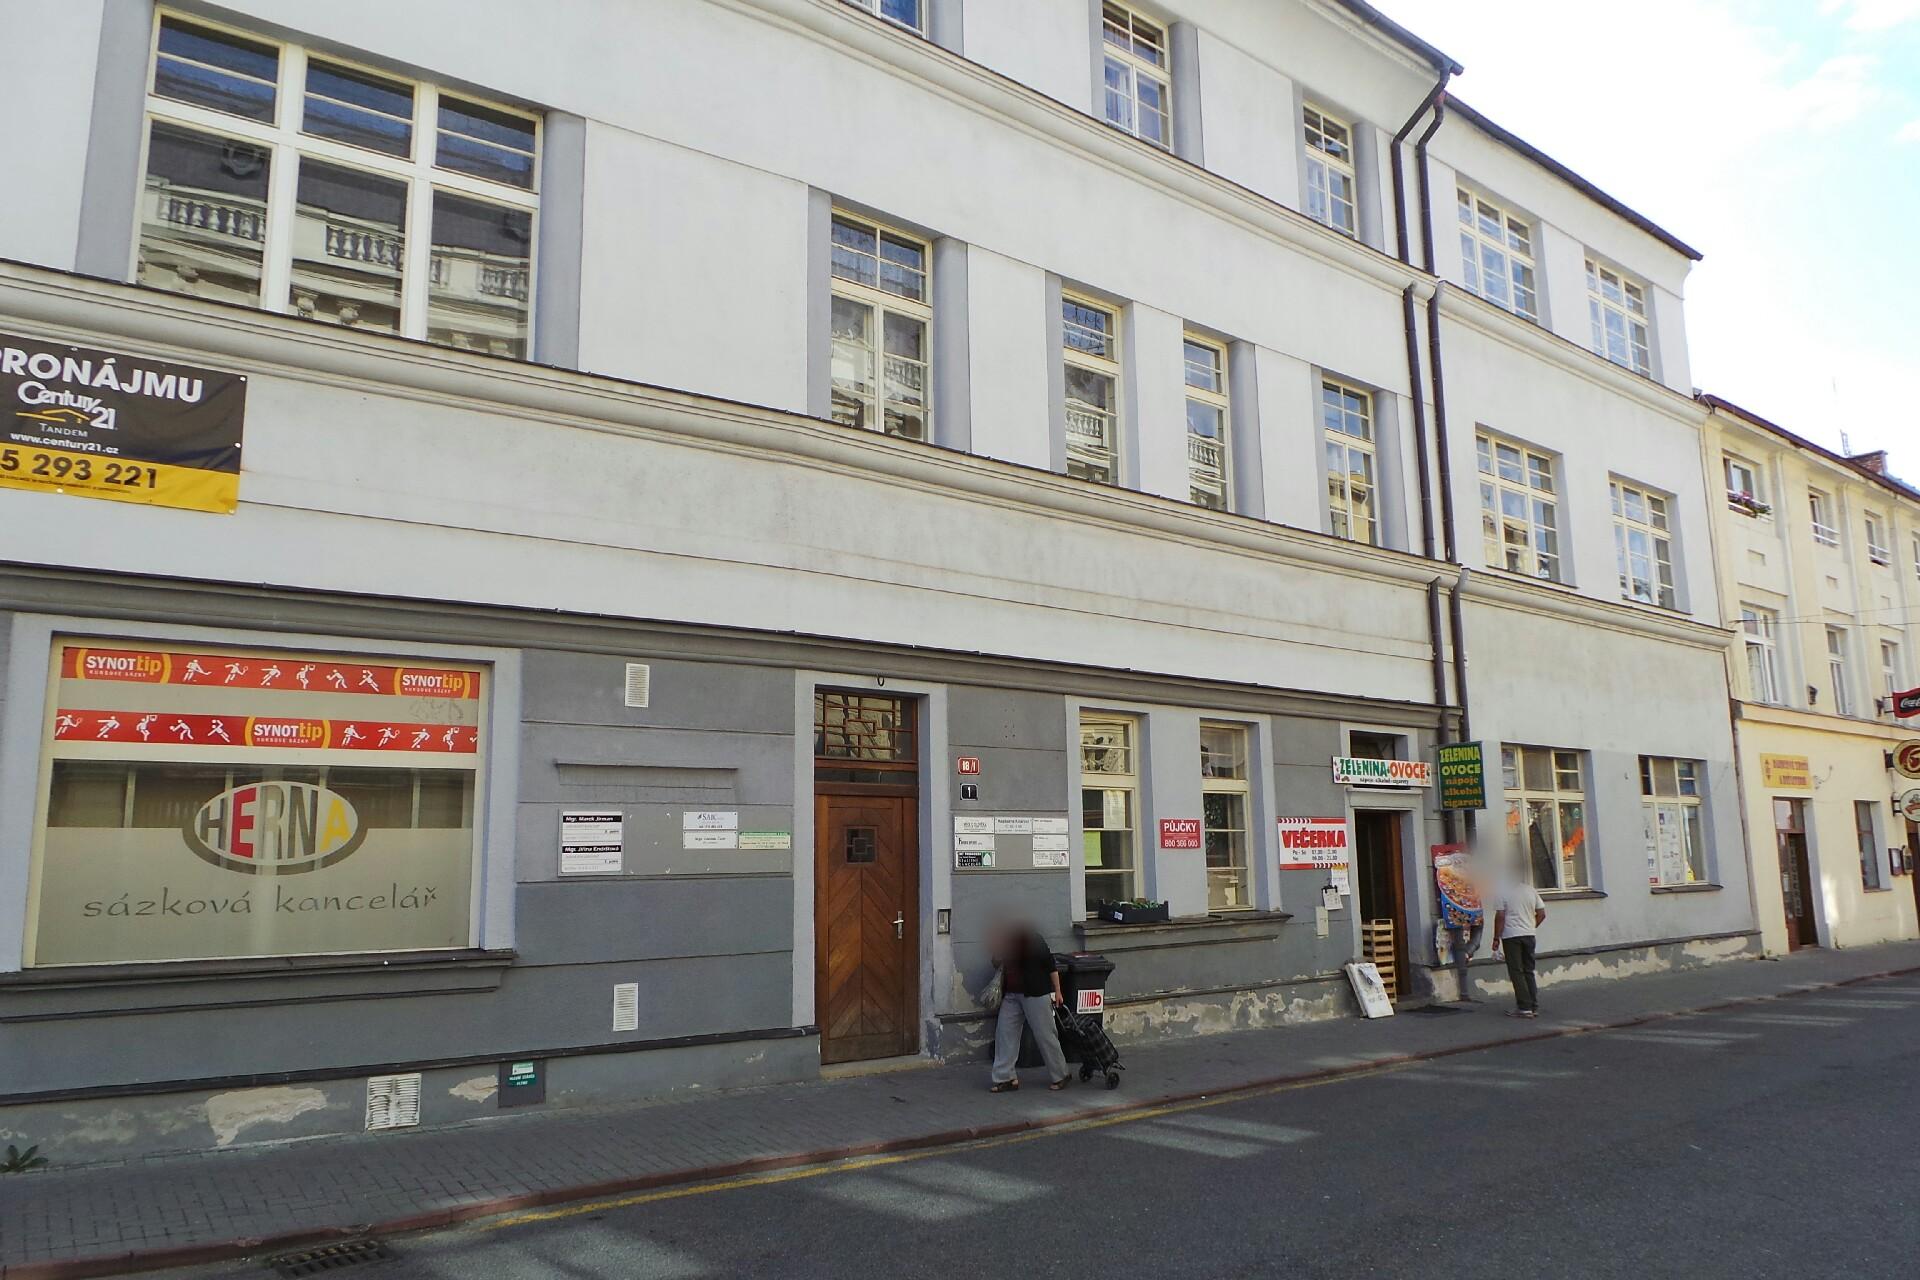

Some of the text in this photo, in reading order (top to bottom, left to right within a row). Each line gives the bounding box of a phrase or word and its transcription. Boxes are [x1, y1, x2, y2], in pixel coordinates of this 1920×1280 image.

[0, 347, 202, 403] RONÁJMU
[90, 406, 116, 430] 21
[10, 432, 119, 454] www.century21.cz
[31, 453, 92, 480] 293
[103, 463, 157, 489] 221
[1440, 746, 1481, 763] ZELENINA
[1389, 761, 1426, 779] OVOCE
[1441, 764, 1481, 775] OVOCE
[967, 786, 971, 798] 1
[1444, 786, 1483, 796] alkohol
[1443, 798, 1484, 808] cigarety
[200, 785, 351, 860] HERNA
[1164, 820, 1197, 833] PŮJČKY
[1281, 827, 1347, 849] VEČERKA
[83, 882, 438, 918] sázková kancelář
